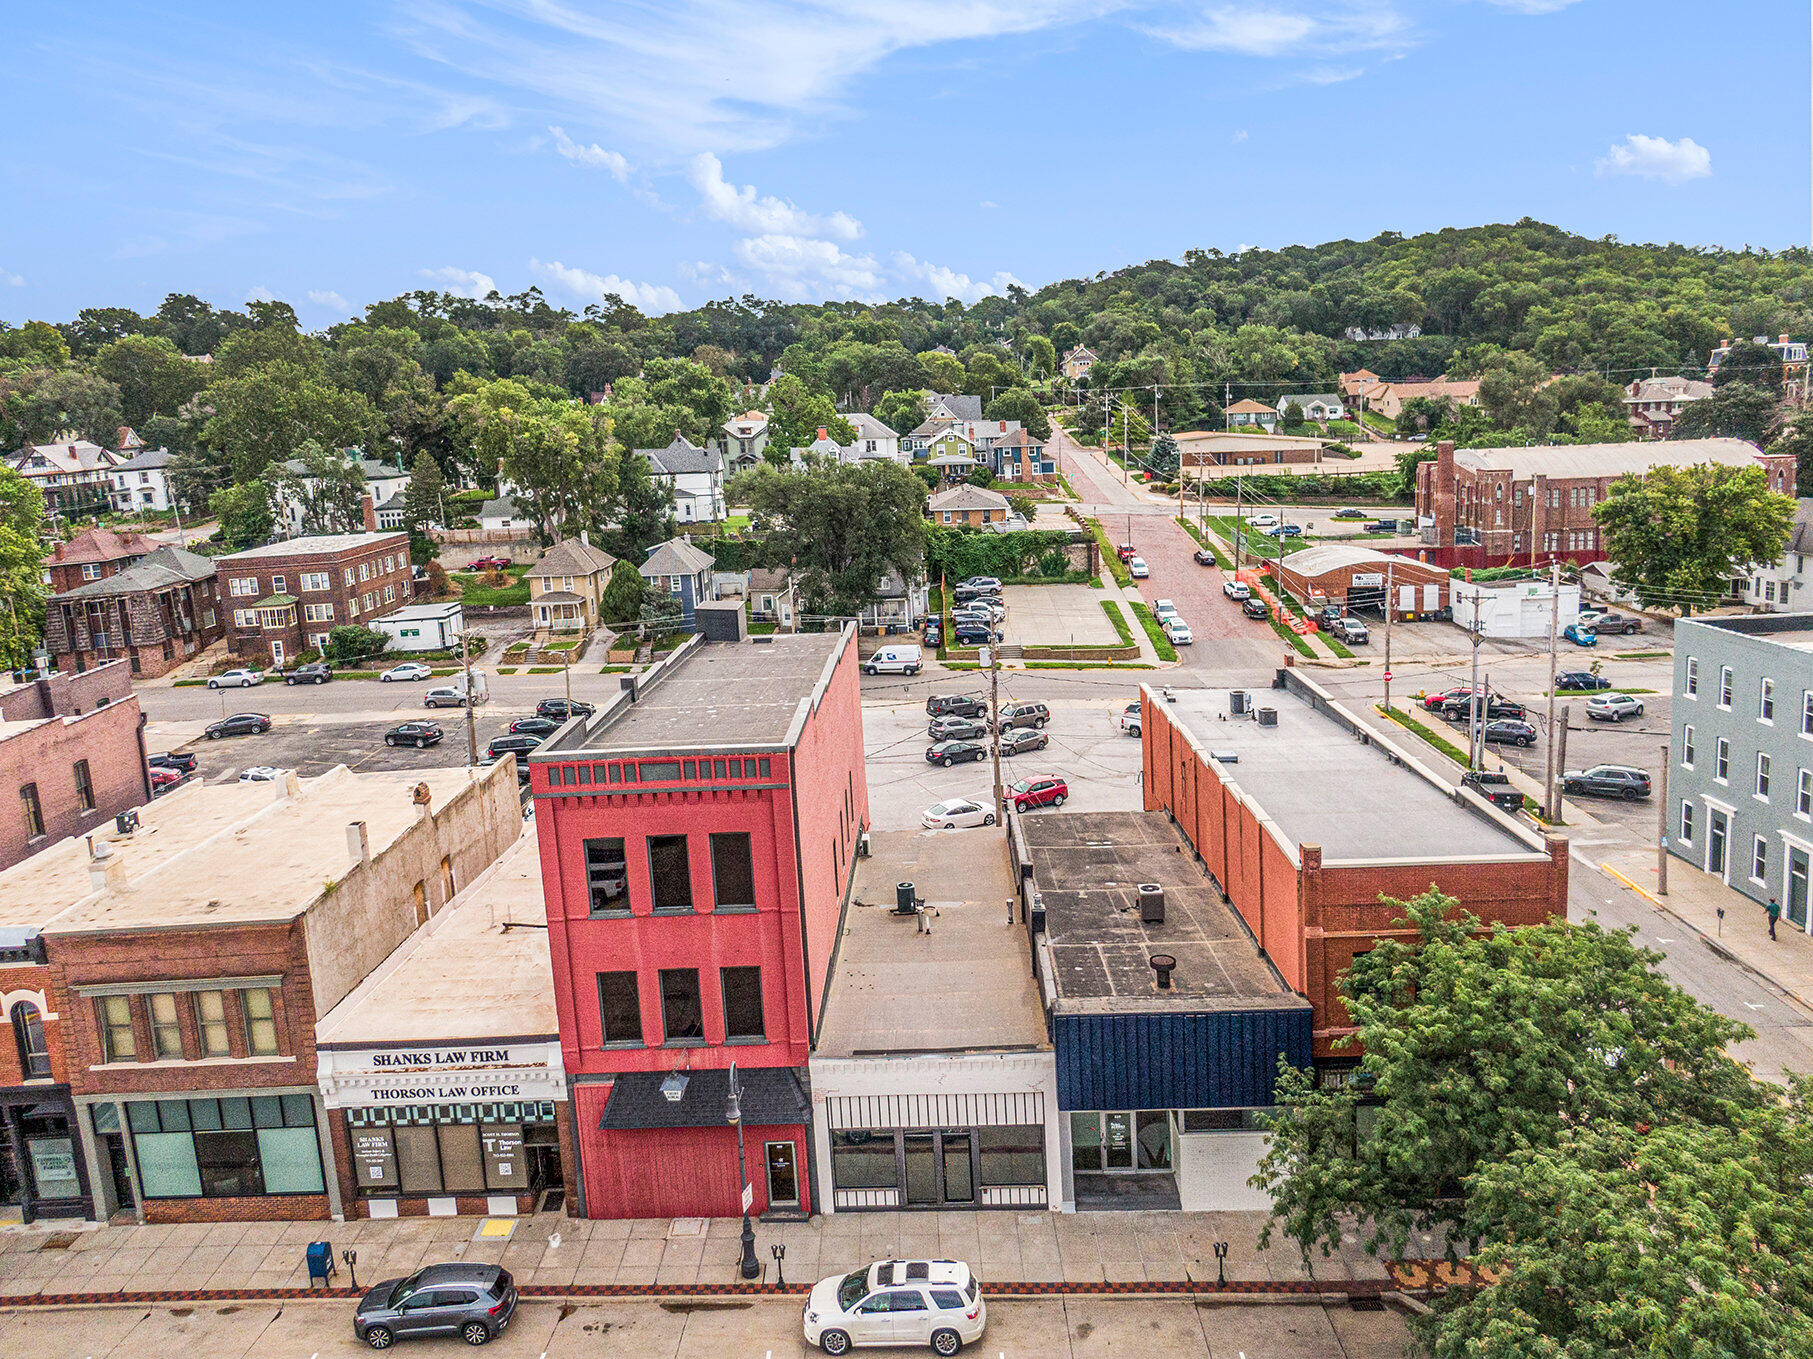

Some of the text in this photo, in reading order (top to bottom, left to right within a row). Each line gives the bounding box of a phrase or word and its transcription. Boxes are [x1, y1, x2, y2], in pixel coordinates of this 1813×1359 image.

[373, 1050, 510, 1066] SHANKS LAW FIRM
[371, 1084, 520, 1100] THORSON LAW OFFICE
